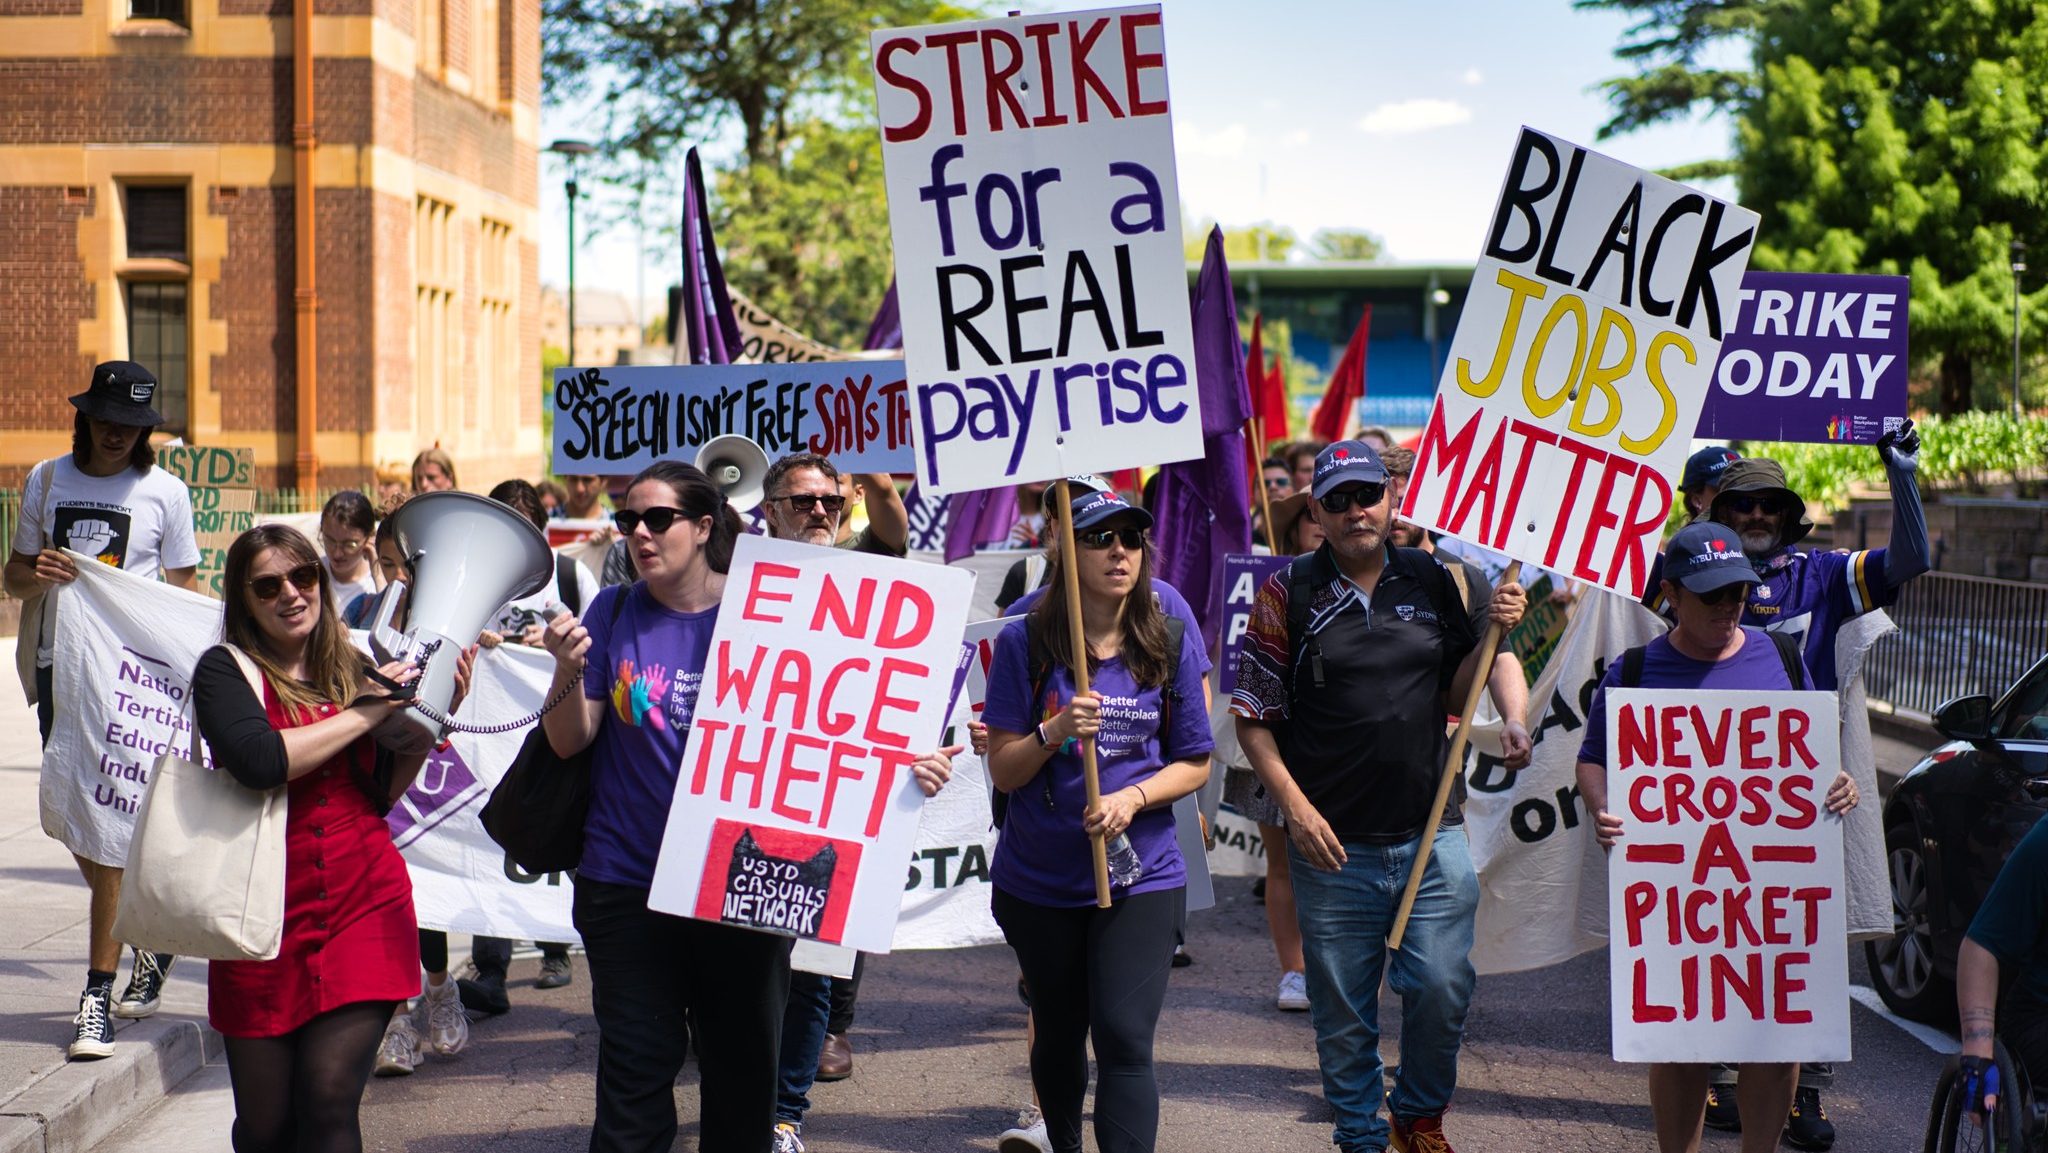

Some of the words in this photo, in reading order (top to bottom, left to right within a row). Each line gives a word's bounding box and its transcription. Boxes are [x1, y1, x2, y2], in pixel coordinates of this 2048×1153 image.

[876, 12, 1169, 143] STRIKE
[919, 144, 1061, 257] for
[1109, 161, 1165, 235] a
[1486, 128, 1755, 341] BLACK
[935, 244, 1165, 371] REAL
[1725, 288, 1897, 340] TRIKE
[1456, 269, 1698, 457] JOBS
[1717, 349, 1896, 401] ODAY
[556, 367, 610, 411] OUR
[563, 386, 670, 461] SPEECH
[676, 386, 744, 448] ISN'T
[745, 379, 812, 453] FREE
[917, 368, 1041, 487] pay
[1054, 353, 1189, 432] rise
[97, 502, 132, 513] SUPPORT
[1400, 393, 1673, 600] MATTER
[192, 511, 254, 533] ROFITS
[1690, 553, 1712, 565] NTEU
[742, 561, 935, 650] END
[1227, 613, 1250, 646] P
[118, 660, 184, 700] Natio
[676, 669, 703, 681] Bette
[715, 640, 930, 749] WAGE
[114, 691, 192, 733] Tertiar
[671, 704, 693, 716] Univ
[1100, 720, 1131, 730] Better
[1103, 696, 1138, 706] Better
[1618, 703, 1821, 771] NEVER
[100, 754, 149, 785] Indu
[690, 719, 917, 838] THEFT
[95, 784, 141, 814] Uni
[1628, 775, 1818, 830] CROSS
[1213, 824, 1265, 858] NATI
[734, 874, 827, 909] CASUALS
[743, 857, 799, 880] USYD
[722, 892, 818, 934] NETWORK
[1624, 881, 1833, 949] PICKET
[1632, 952, 1814, 1025] LINE
